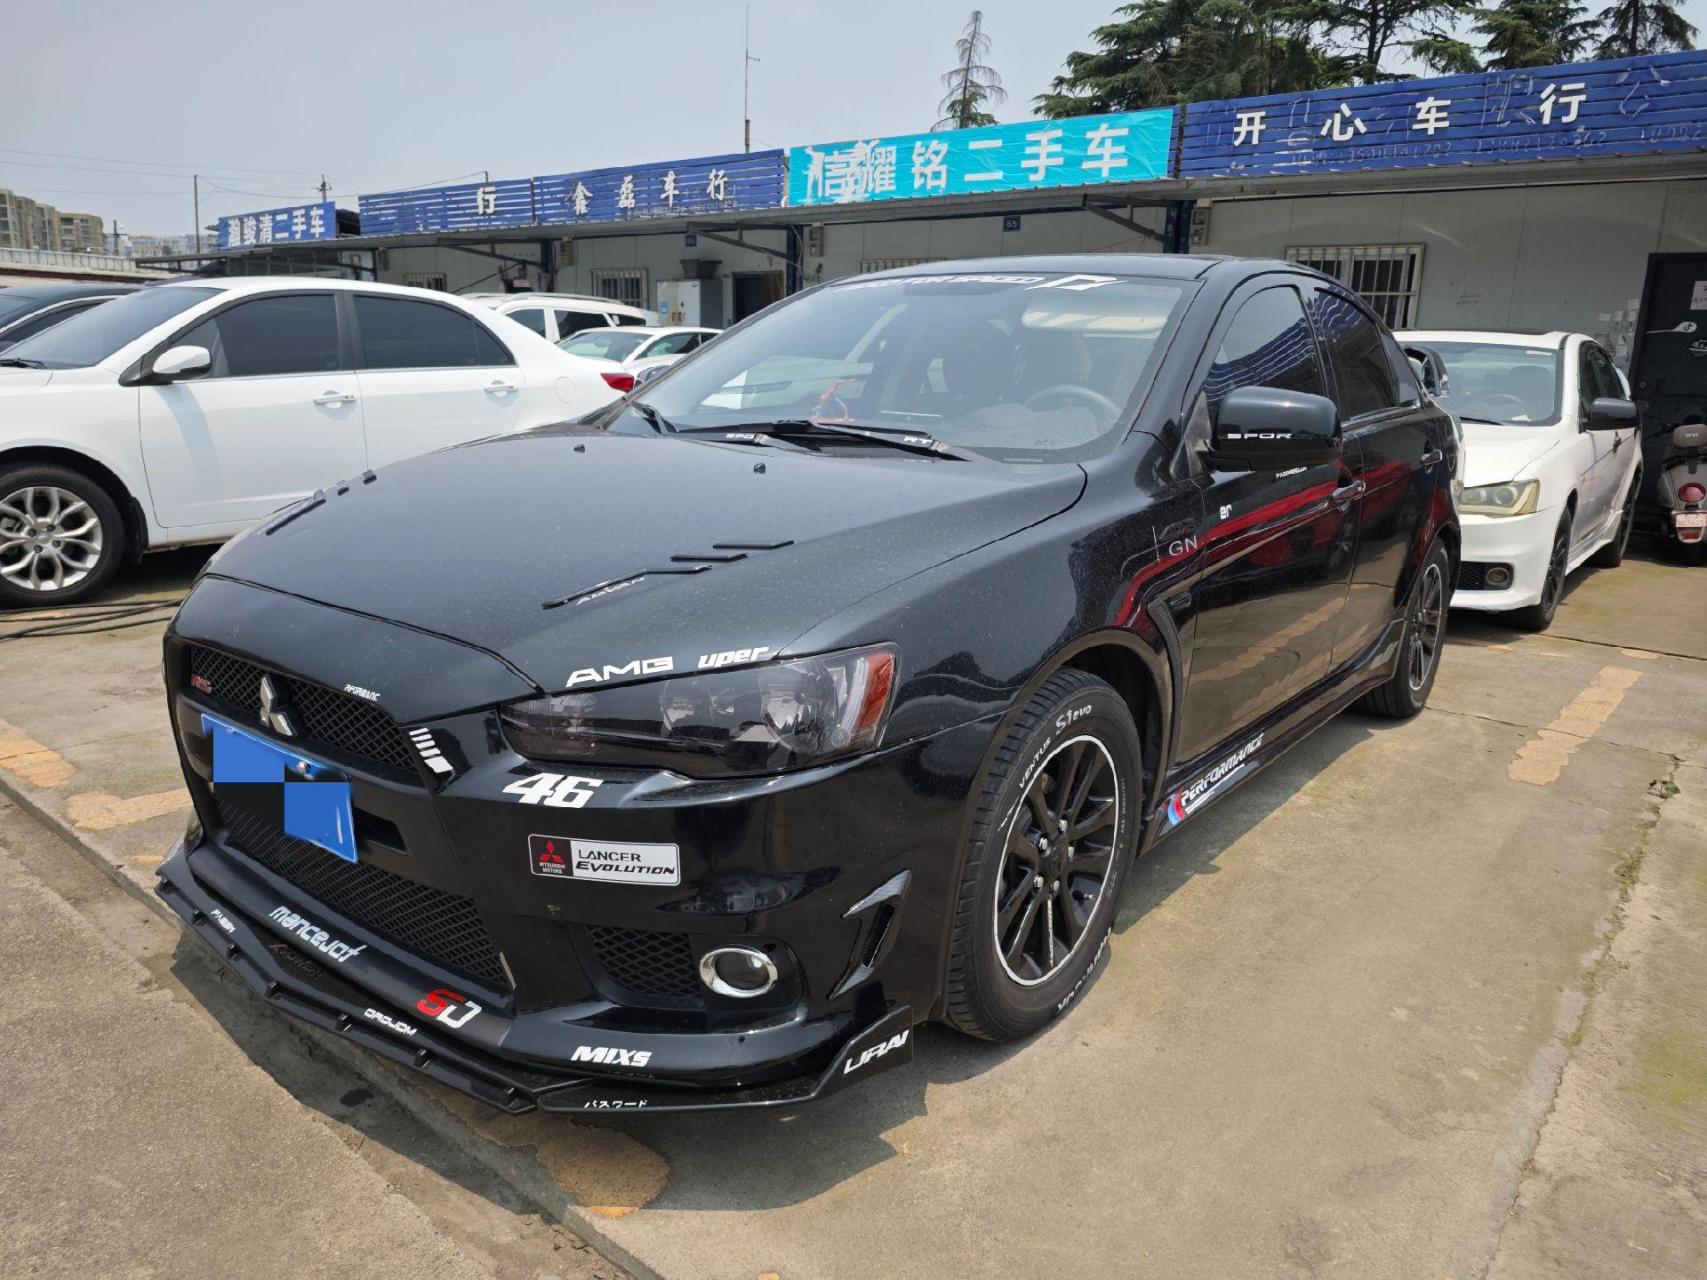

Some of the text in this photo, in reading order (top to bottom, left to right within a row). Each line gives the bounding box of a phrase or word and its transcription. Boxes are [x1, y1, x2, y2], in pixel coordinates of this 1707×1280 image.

[1234, 82, 1587, 146] 开心车行
[477, 186, 496, 215] 行
[566, 656, 673, 688] AMG
[698, 646, 770, 669] uper
[1019, 736, 1051, 789] VENTUS
[502, 772, 604, 808] 46
[575, 861, 675, 875] EVOLUTION
[578, 849, 641, 862] LANCER
[570, 1045, 652, 1067] MIXS
